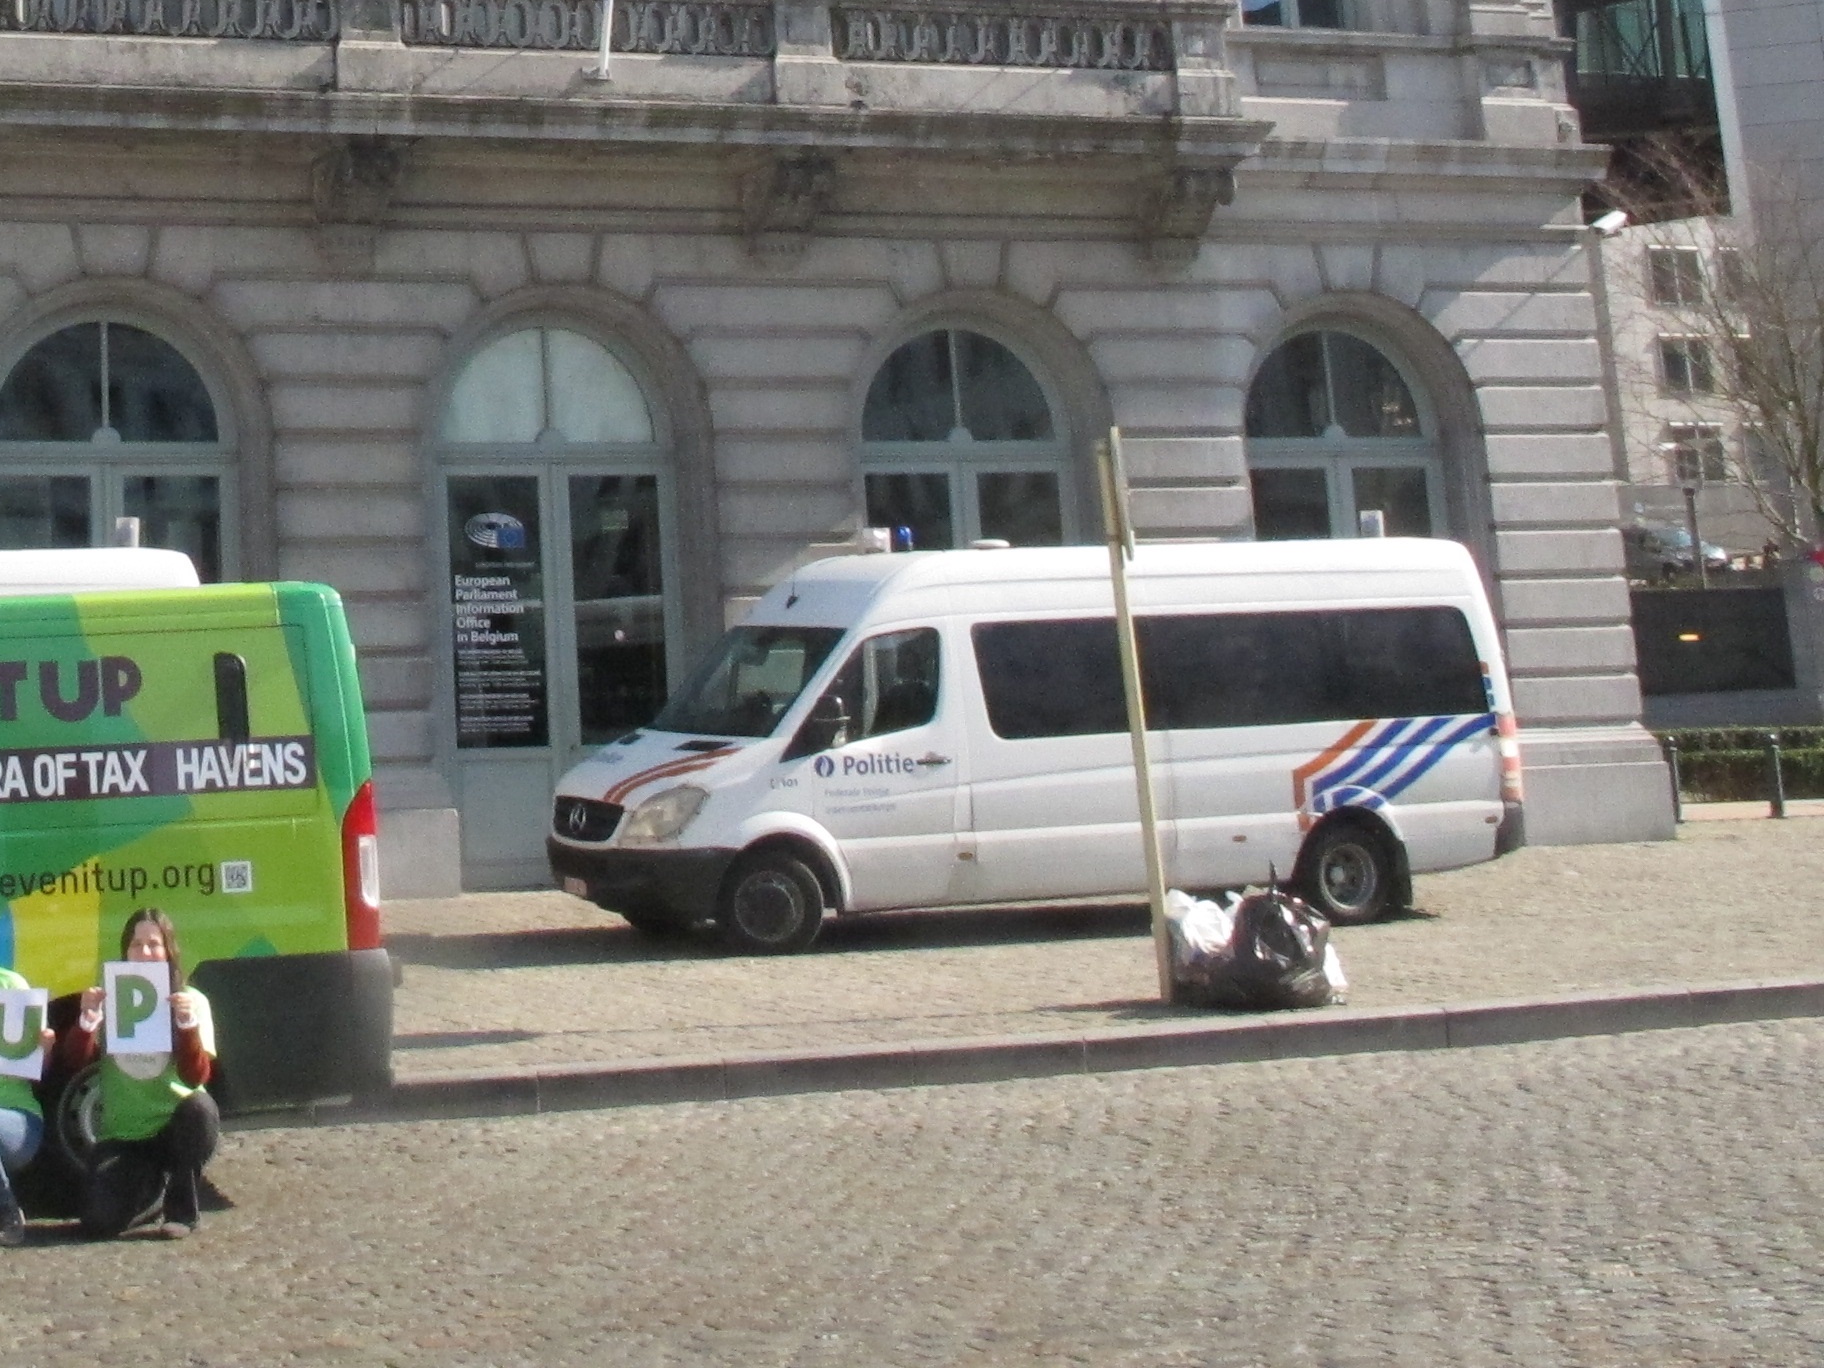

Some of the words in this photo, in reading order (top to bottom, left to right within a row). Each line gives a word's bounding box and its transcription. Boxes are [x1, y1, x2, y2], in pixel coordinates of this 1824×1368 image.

[454, 575, 510, 588] European
[455, 589, 518, 601] Parliament
[456, 602, 524, 614] Information
[457, 617, 492, 629] Office
[457, 631, 468, 642] in
[471, 630, 519, 645] Belgium
[38, 655, 143, 723] UP
[33, 751, 78, 797] OF
[81, 749, 150, 795] TAX
[176, 741, 308, 791] HAVENS
[843, 753, 915, 776] Politie
[115, 973, 159, 1039] P
